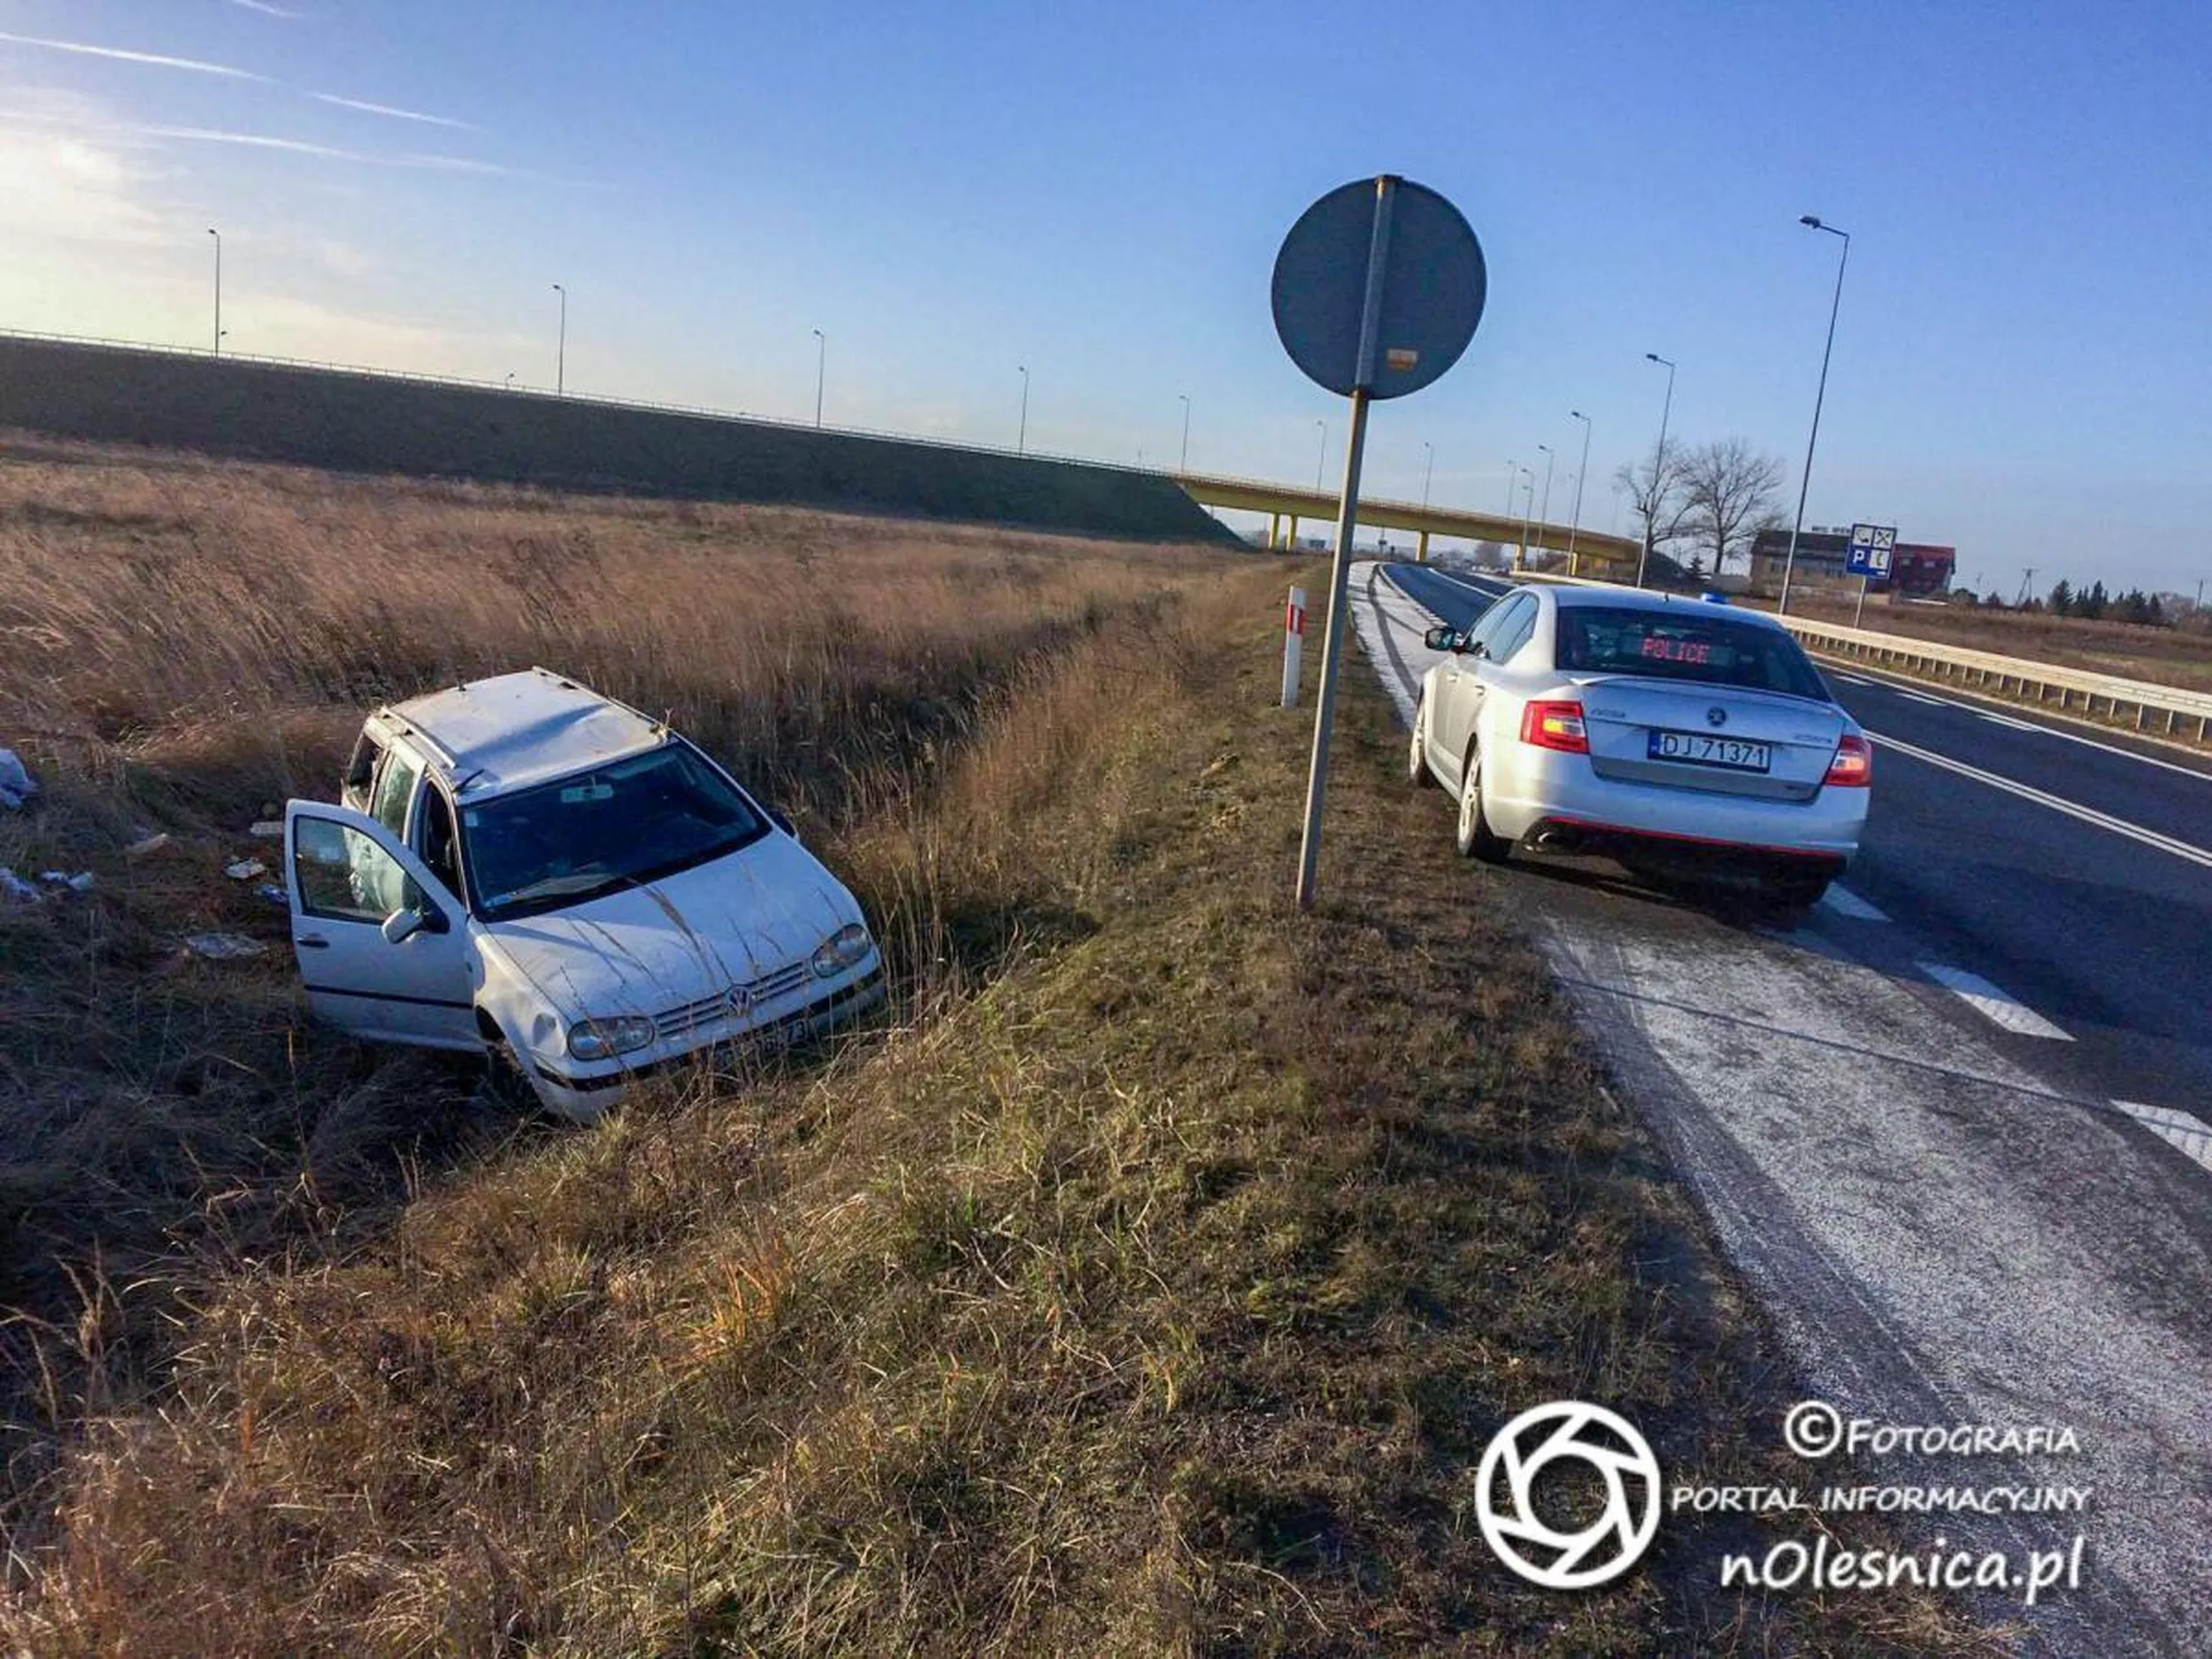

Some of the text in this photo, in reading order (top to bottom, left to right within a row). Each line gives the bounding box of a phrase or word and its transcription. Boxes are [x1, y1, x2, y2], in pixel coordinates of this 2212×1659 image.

[1641, 637, 1710, 664] POLICE
[1663, 735, 1764, 767] DJ 71371
